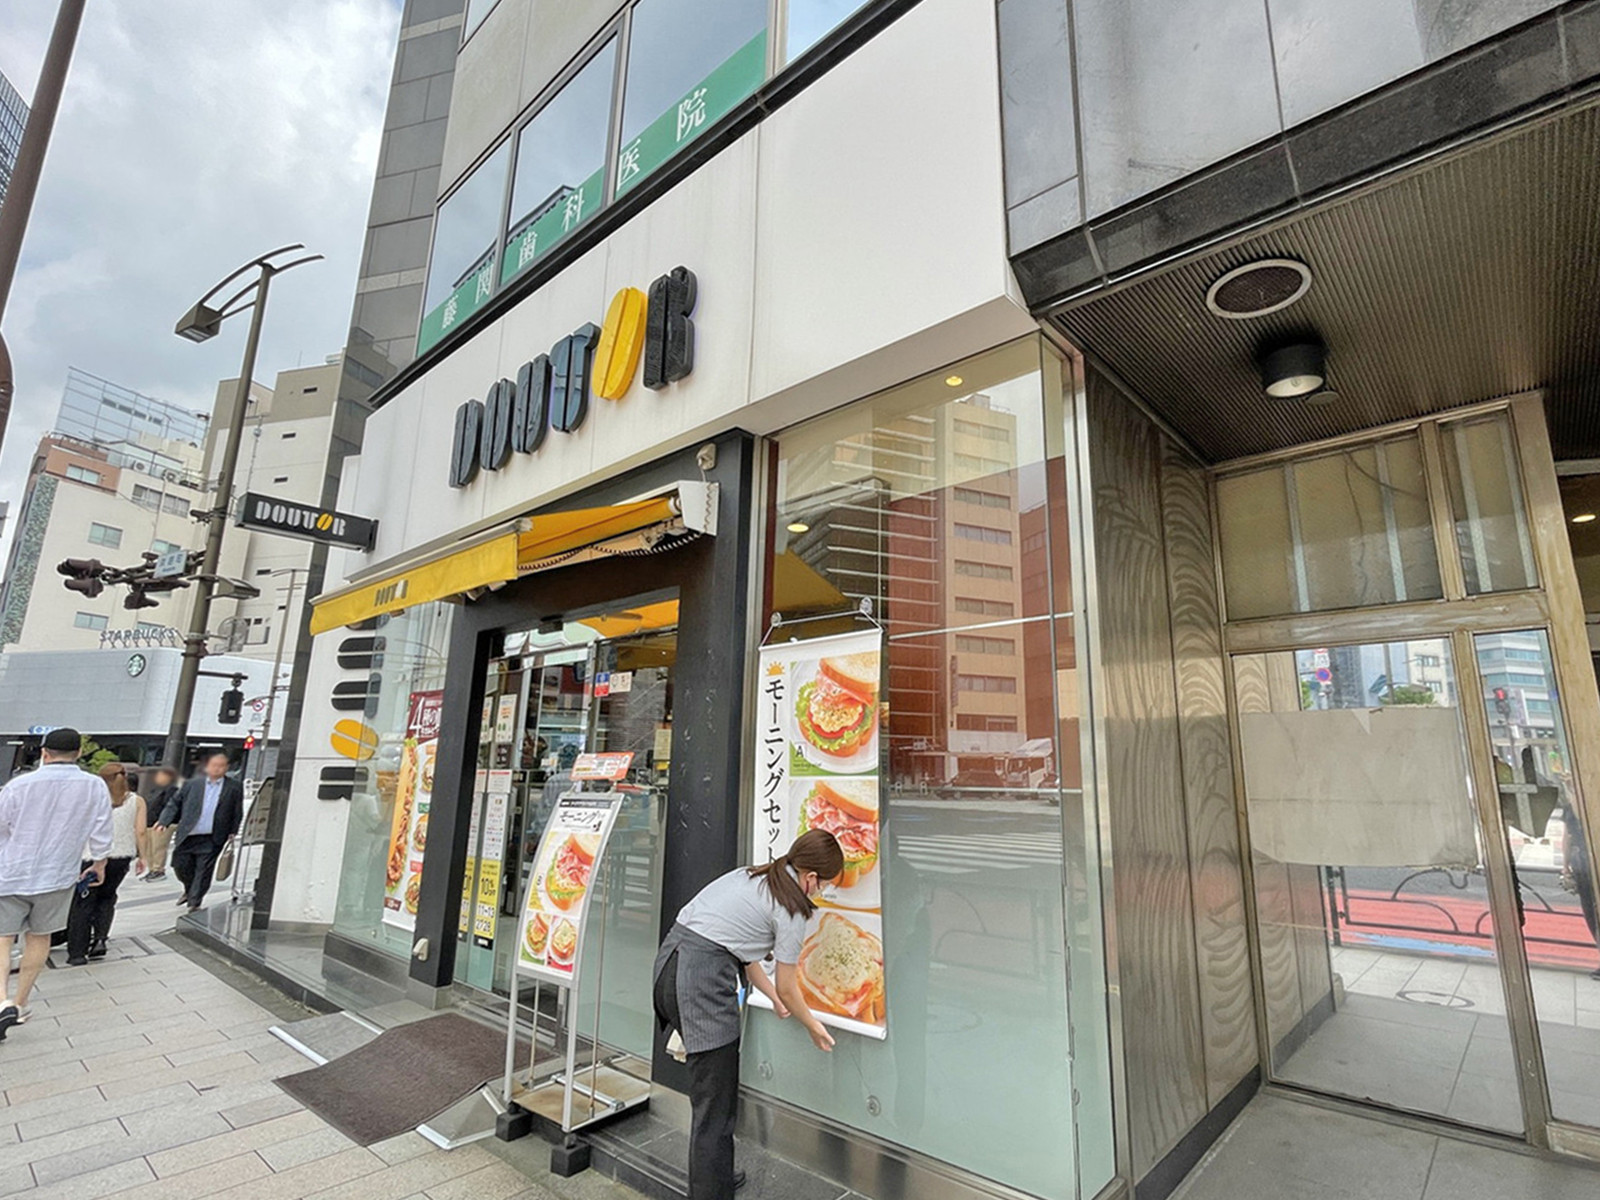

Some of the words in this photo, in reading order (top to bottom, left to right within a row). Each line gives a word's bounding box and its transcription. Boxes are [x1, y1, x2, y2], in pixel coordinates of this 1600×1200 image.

[449, 265, 698, 489] DOUTOR
[255, 500, 347, 536] DOUTOR
[99, 627, 176, 643] STARBUCKS
[795, 744, 805, 759] A
[763, 679, 785, 863] モーニングセット
